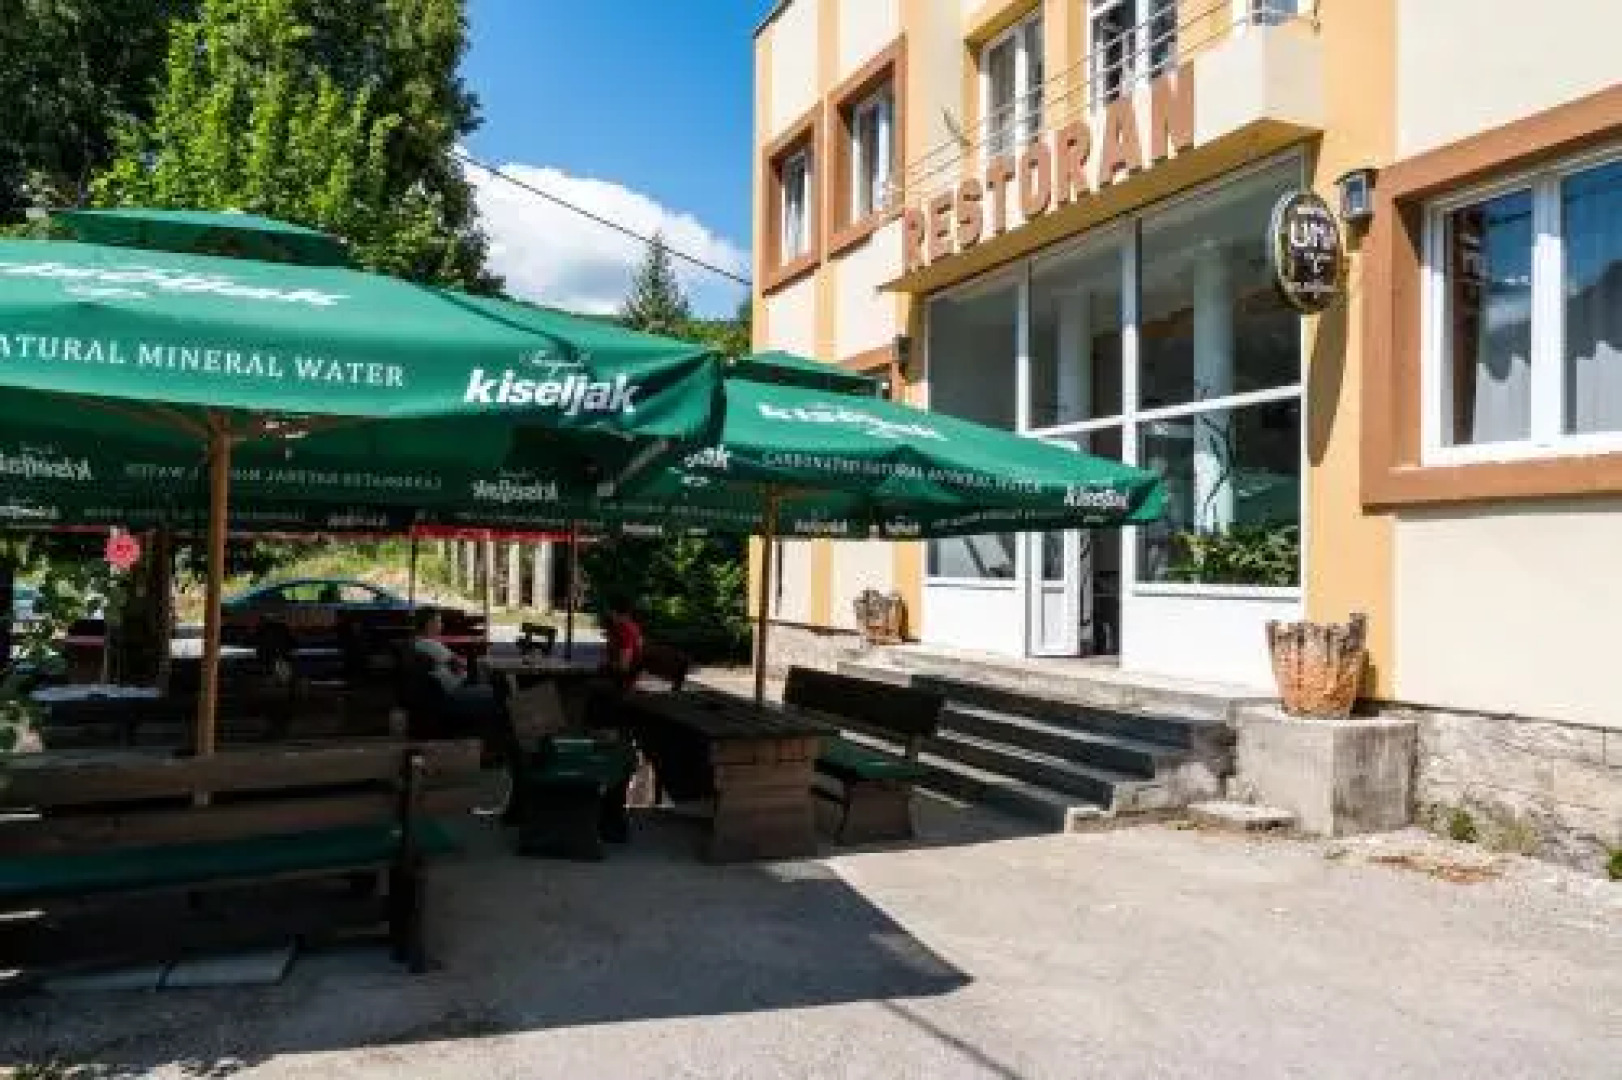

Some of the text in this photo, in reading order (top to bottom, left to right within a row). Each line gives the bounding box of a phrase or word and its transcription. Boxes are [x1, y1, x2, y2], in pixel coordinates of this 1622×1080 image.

[904, 62, 1195, 272] RESTORAN
[138, 342, 284, 378] MINERAL
[295, 355, 404, 388] WATER
[463, 366, 637, 417] kiseljak
